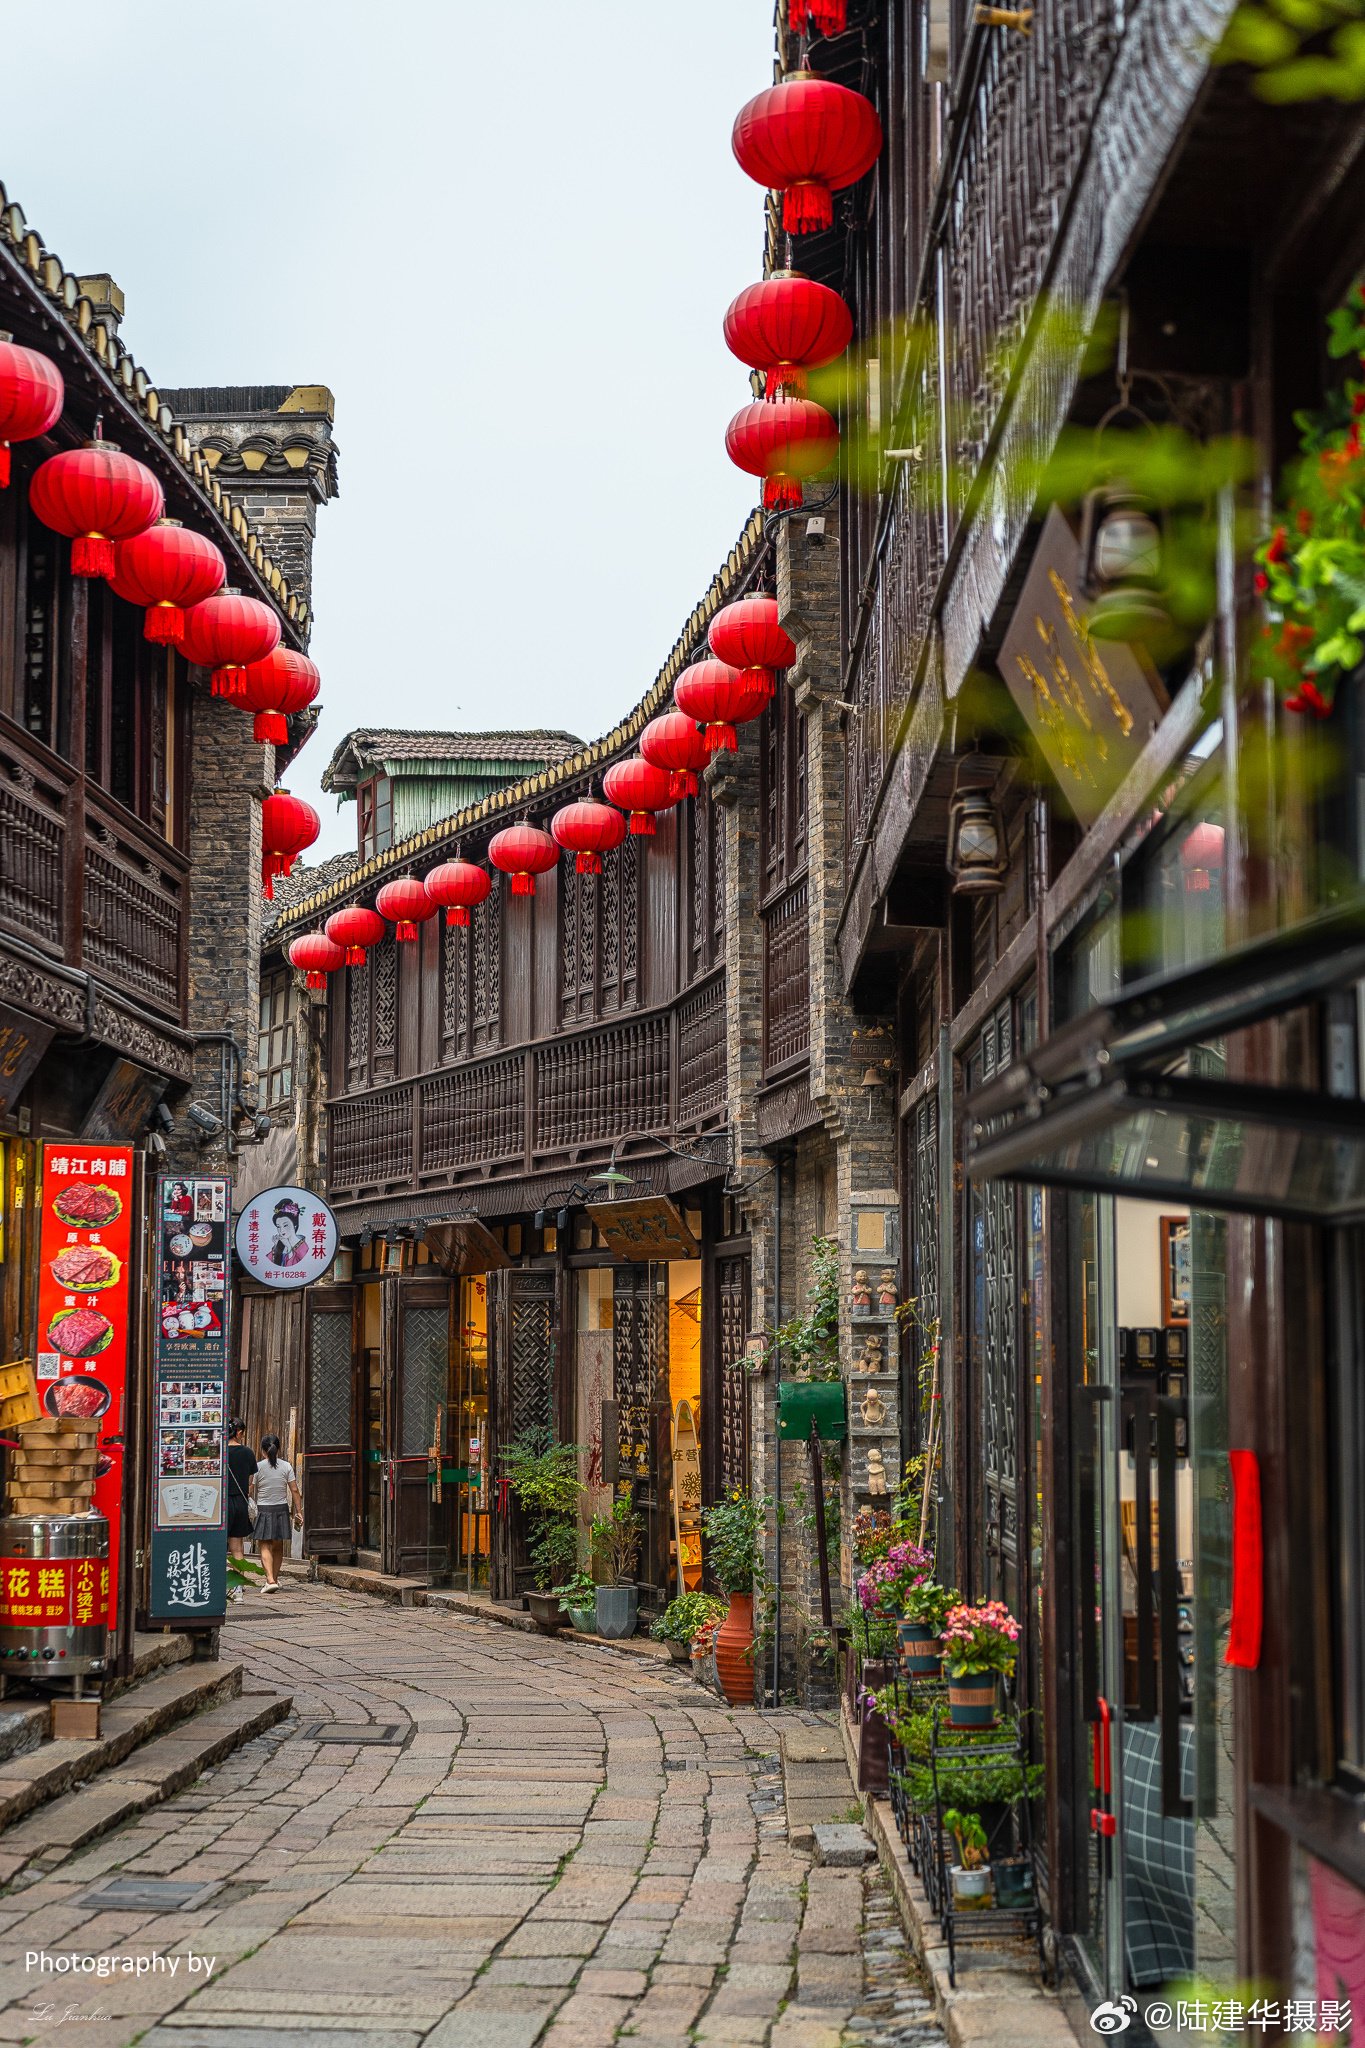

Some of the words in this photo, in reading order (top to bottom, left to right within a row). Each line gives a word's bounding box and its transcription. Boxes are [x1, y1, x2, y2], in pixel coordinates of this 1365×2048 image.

[51, 1157, 127, 1176] 靖江肉脯
[66, 1232, 101, 1243] 原味
[248, 1209, 260, 1266] 非遗老字号
[312, 1213, 326, 1260] 戴春林
[264, 1271, 307, 1279] 始于1628年
[64, 1295, 99, 1307] 蜜汁
[62, 1360, 97, 1371] 香辣
[0, 1567, 66, 1599] 花糕
[76, 1560, 95, 1624] 小心烫手
[200, 1564, 212, 1601] 老字号
[45, 1604, 65, 1616] 豆沙
